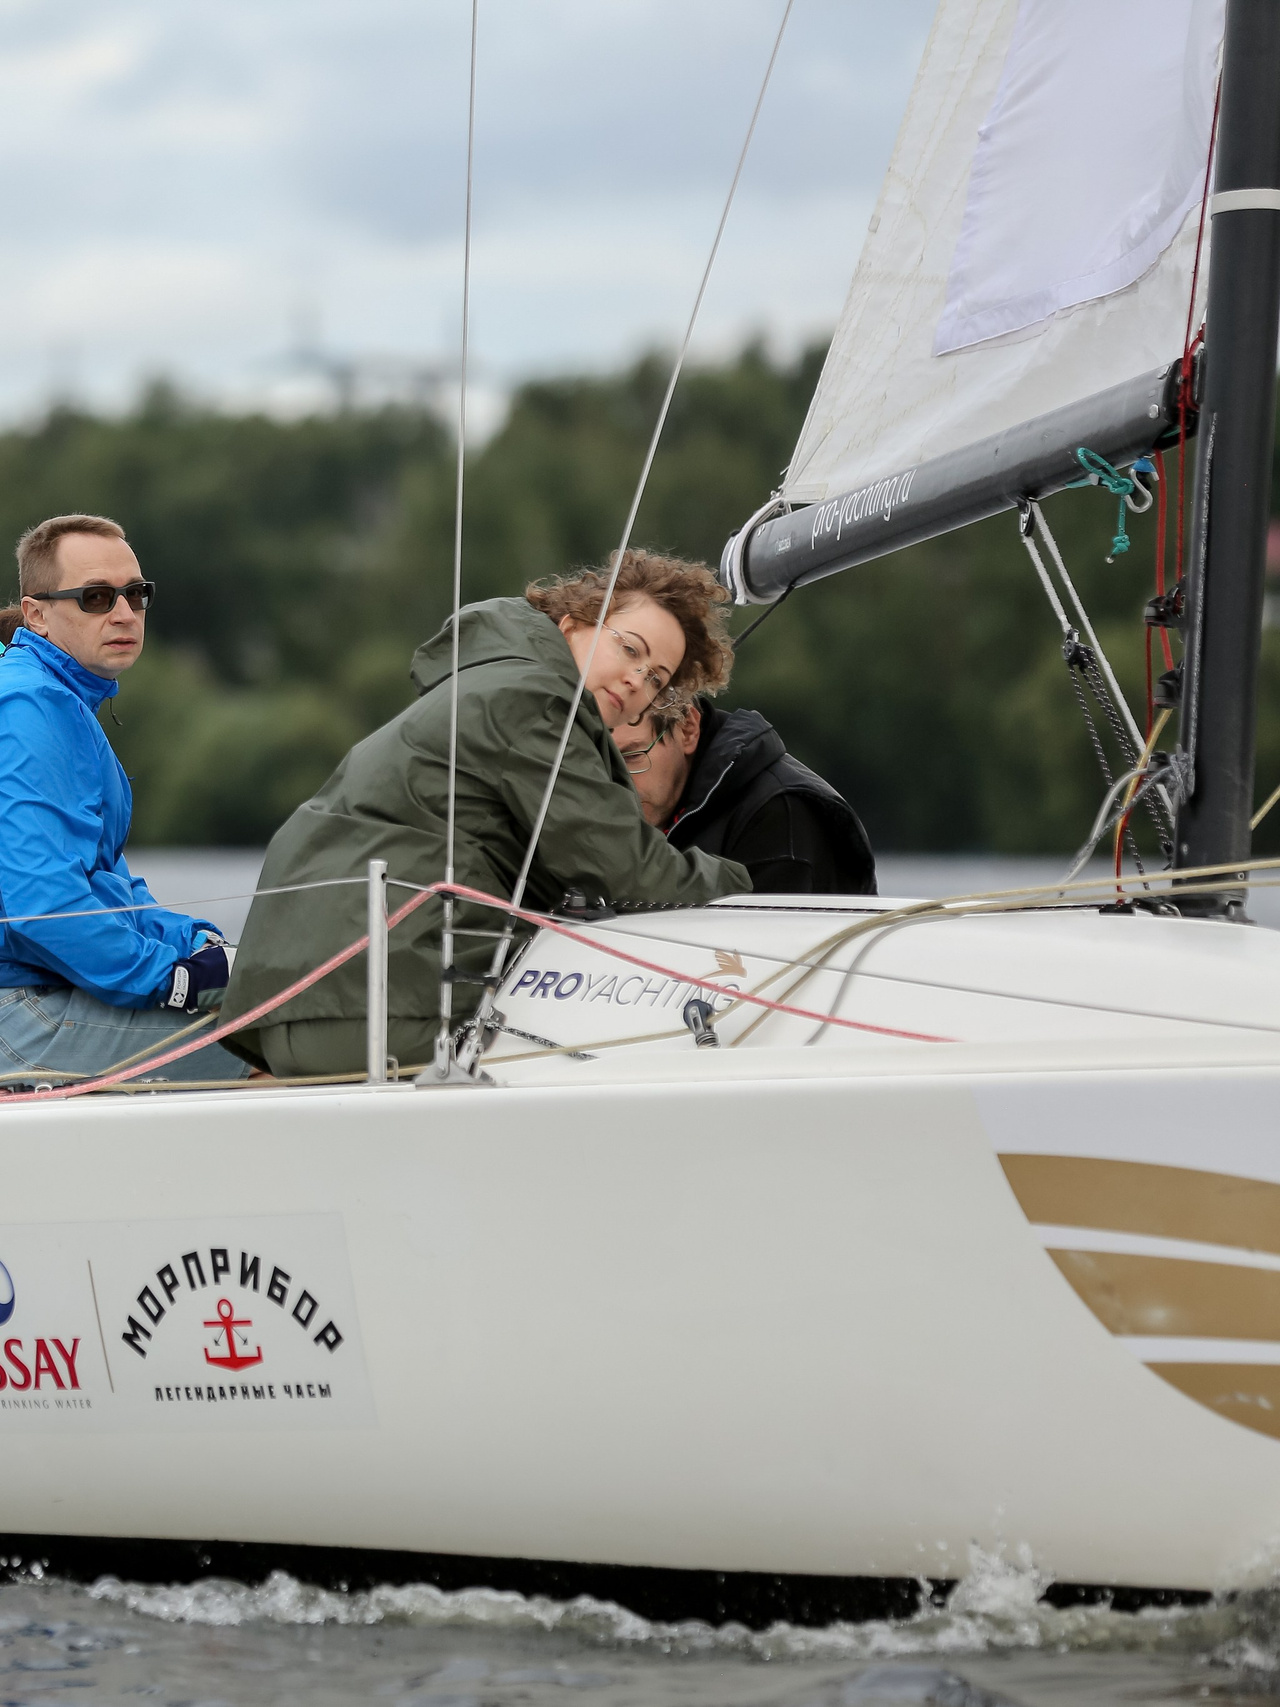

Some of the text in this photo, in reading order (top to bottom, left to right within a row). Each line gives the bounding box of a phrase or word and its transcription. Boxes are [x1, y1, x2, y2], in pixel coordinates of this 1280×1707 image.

[811, 469, 917, 550] pro-yachting.ru
[122, 1248, 344, 1359] МОРПРИБОР
[54, 1399, 93, 1410] WATER
[154, 1384, 332, 1402] ЛЕГЕНДАРНЫЕ ЧАСЫ
